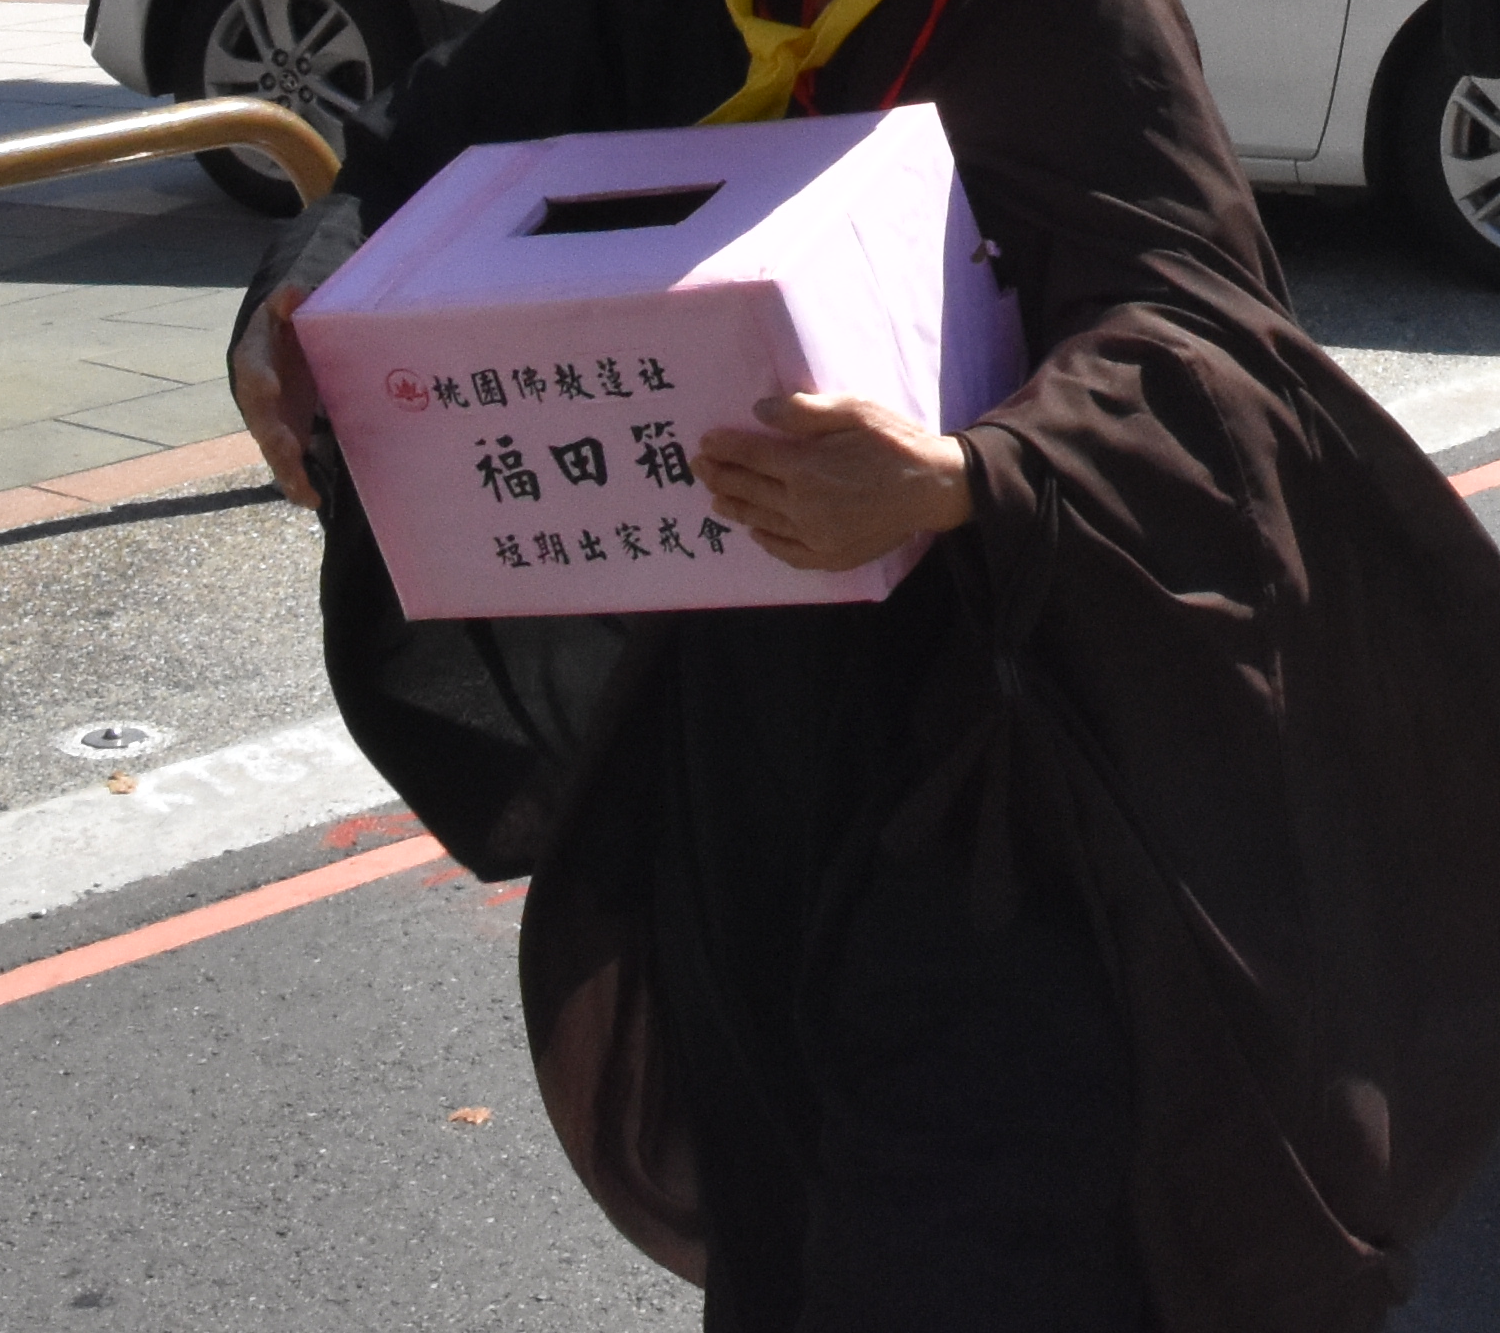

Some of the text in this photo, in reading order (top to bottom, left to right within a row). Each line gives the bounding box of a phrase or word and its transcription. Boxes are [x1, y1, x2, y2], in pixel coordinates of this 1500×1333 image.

[431, 357, 676, 410] 桃園佛教蓮社
[475, 420, 696, 504] 福田箱
[494, 517, 733, 570] 短期出家戒會
